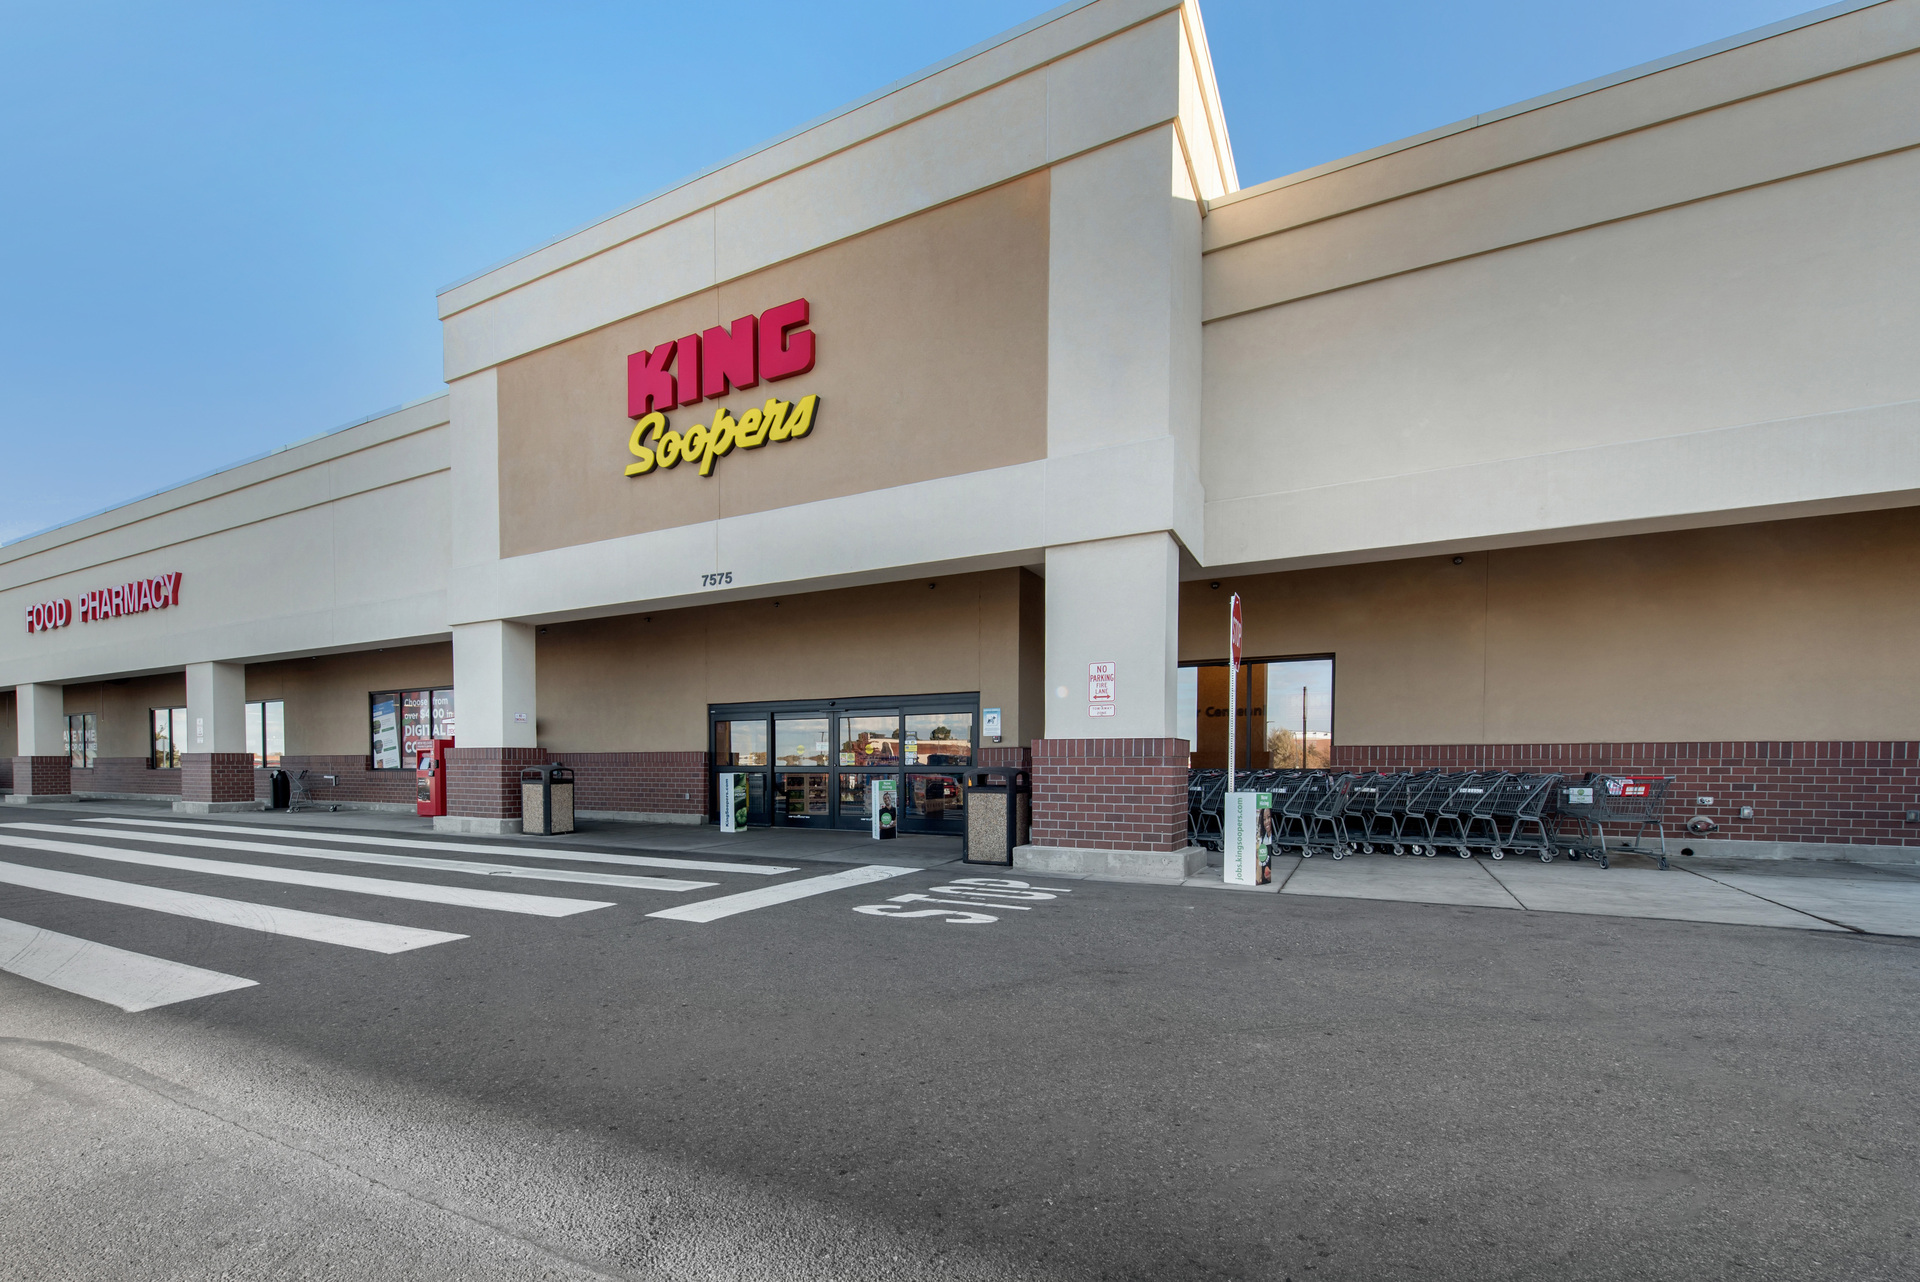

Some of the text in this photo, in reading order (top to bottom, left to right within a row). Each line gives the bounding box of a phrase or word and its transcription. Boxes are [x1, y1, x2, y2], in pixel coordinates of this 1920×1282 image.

[627, 297, 816, 420] KING
[624, 394, 820, 478] Soopers
[701, 571, 733, 587] 7575
[25, 571, 182, 633] FOOD PHARMACY
[1232, 616, 1242, 649] STOP
[1090, 673, 1114, 682] PARKING
[1096, 665, 1108, 673] NO
[404, 696, 449, 706] Choose from
[404, 708, 454, 720] over $400 in
[405, 724, 447, 737] DIGITAL
[1235, 797, 1245, 881] jobs.kingsoopers.com
[852, 878, 1072, 924] STOP
